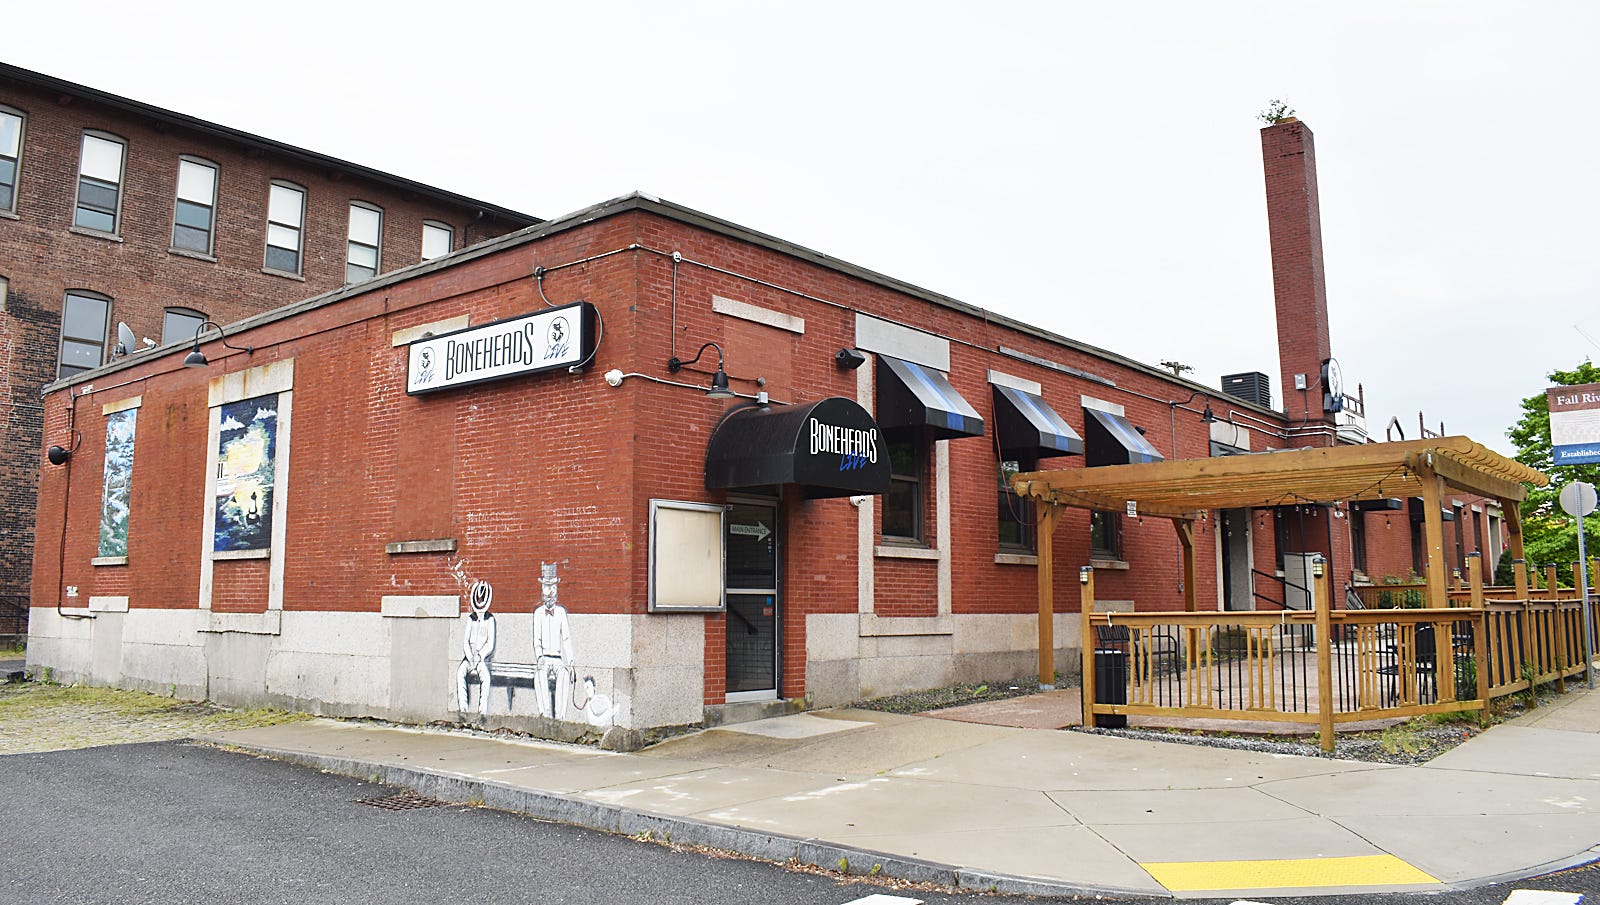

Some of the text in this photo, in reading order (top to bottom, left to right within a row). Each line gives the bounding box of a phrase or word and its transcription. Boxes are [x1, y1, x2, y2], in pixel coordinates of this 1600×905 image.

[446, 322, 534, 381] BONEHEADS
[1557, 394, 1579, 406] Fall
[810, 417, 877, 464] BONEHEADS
[731, 525, 767, 535] MAIN ENTRANCE
